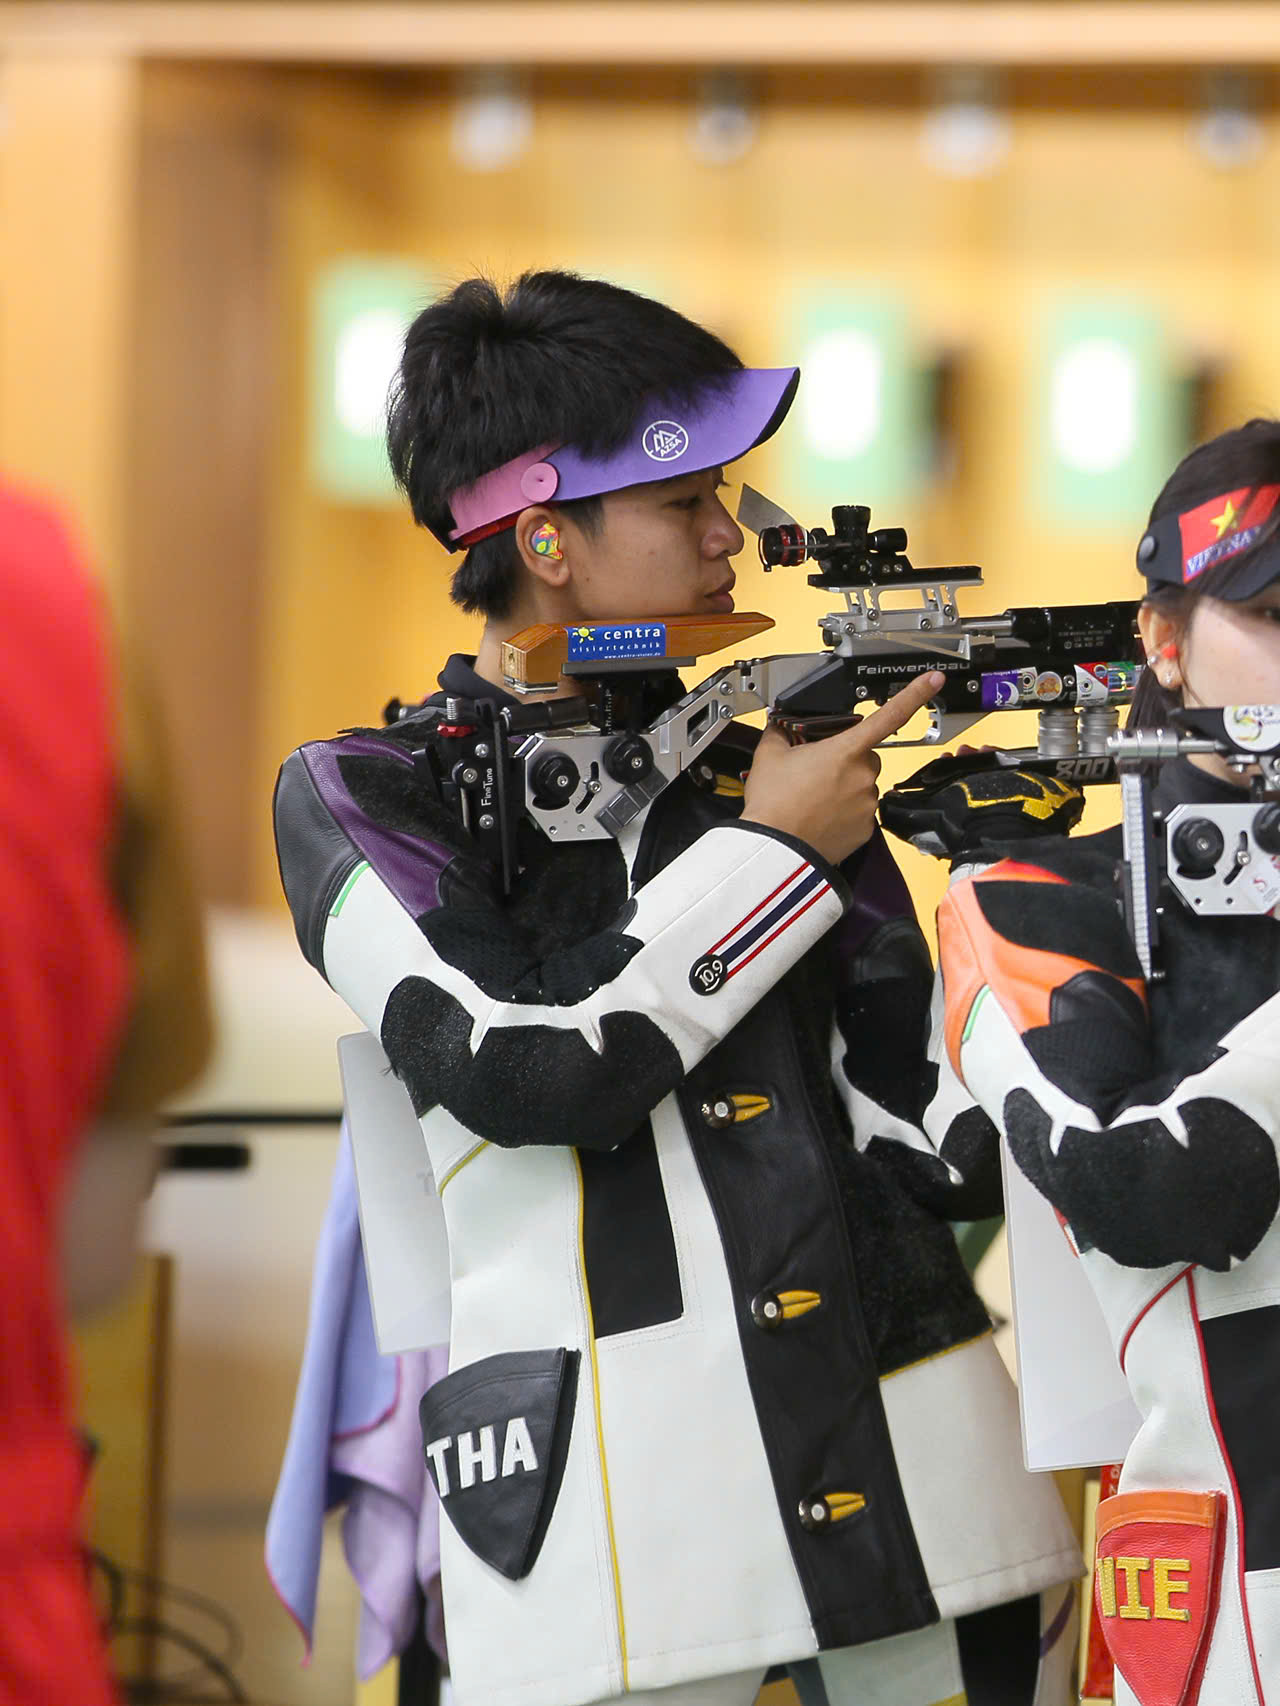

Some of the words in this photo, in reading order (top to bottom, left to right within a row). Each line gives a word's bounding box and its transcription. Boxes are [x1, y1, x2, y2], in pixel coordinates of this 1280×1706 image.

[604, 627, 661, 640] centra
[572, 642, 660, 653] visiertechnik
[857, 661, 971, 676] Feinwerkbau
[1056, 757, 1110, 780] 800
[481, 768, 493, 806] FineTune
[699, 960, 723, 986] 10.9
[427, 1416, 538, 1498] THA
